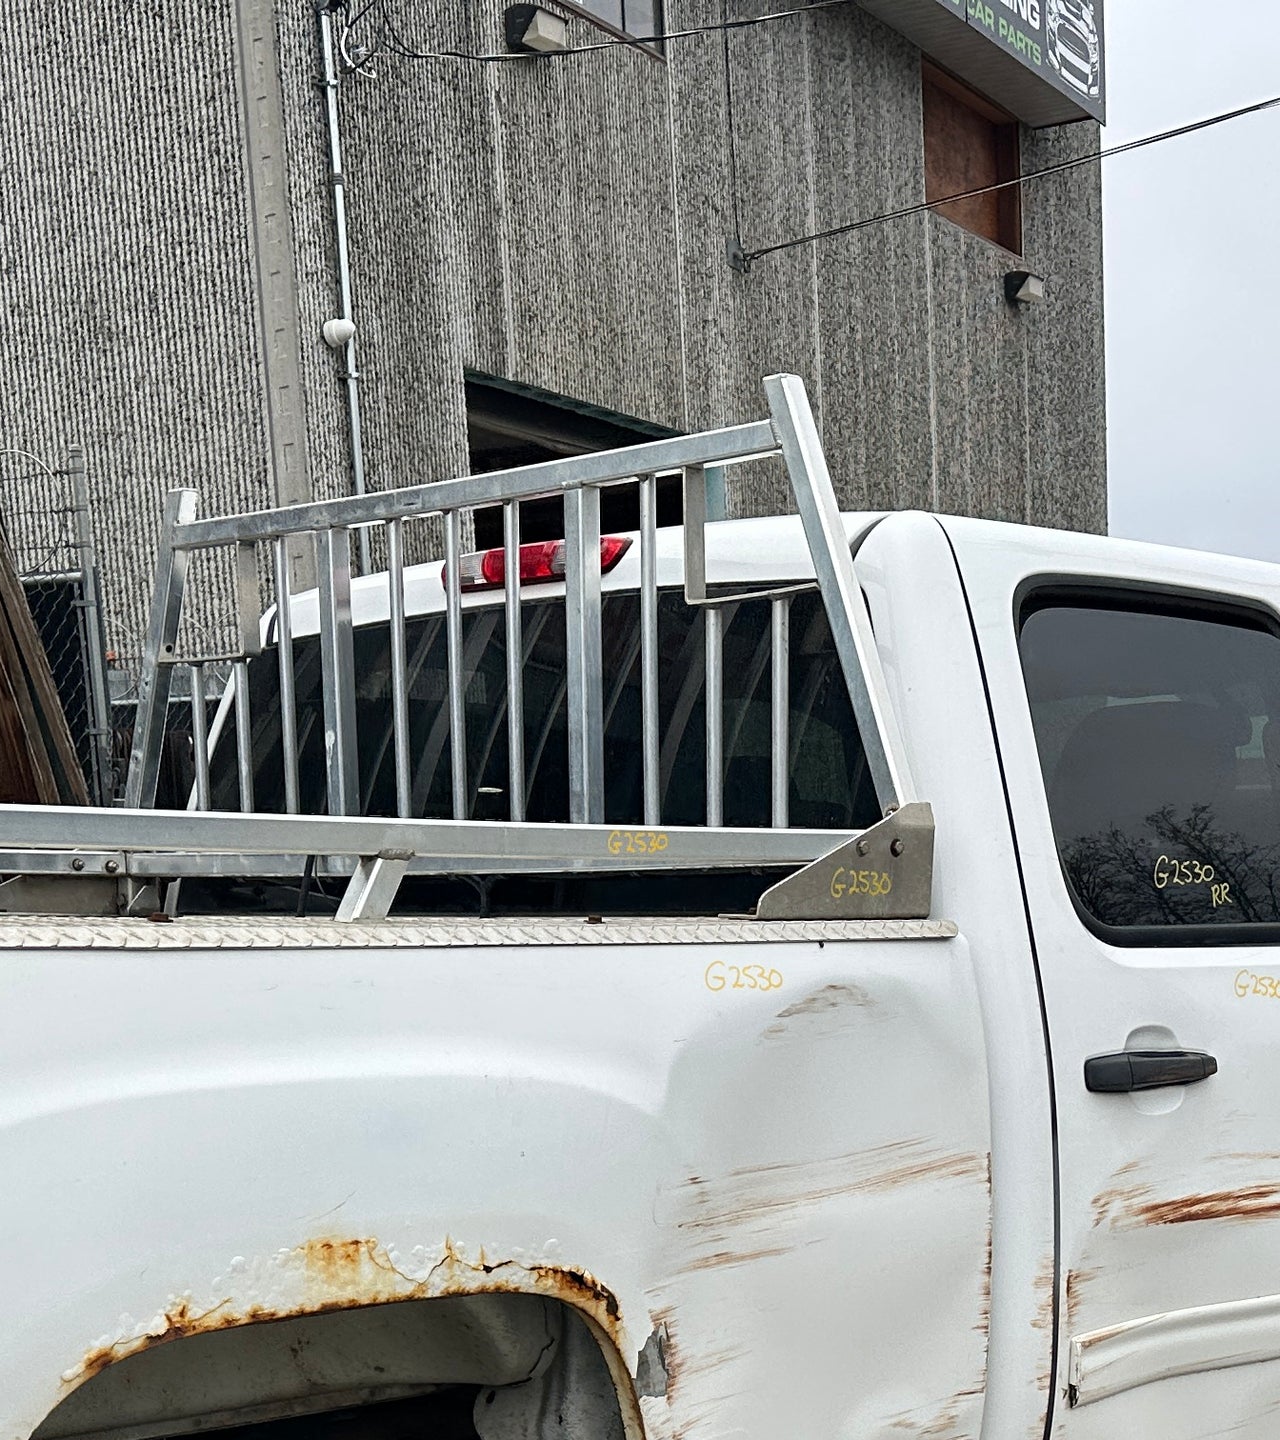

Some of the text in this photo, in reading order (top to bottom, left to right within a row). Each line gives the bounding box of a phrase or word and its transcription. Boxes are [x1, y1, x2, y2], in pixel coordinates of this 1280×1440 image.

[999, 16, 1042, 66] PARTS
[607, 830, 669, 855] G2530
[830, 867, 892, 898] G2530
[1154, 855, 1215, 888] G2530
[1211, 883, 1232, 908] RR
[704, 961, 784, 992] G2530
